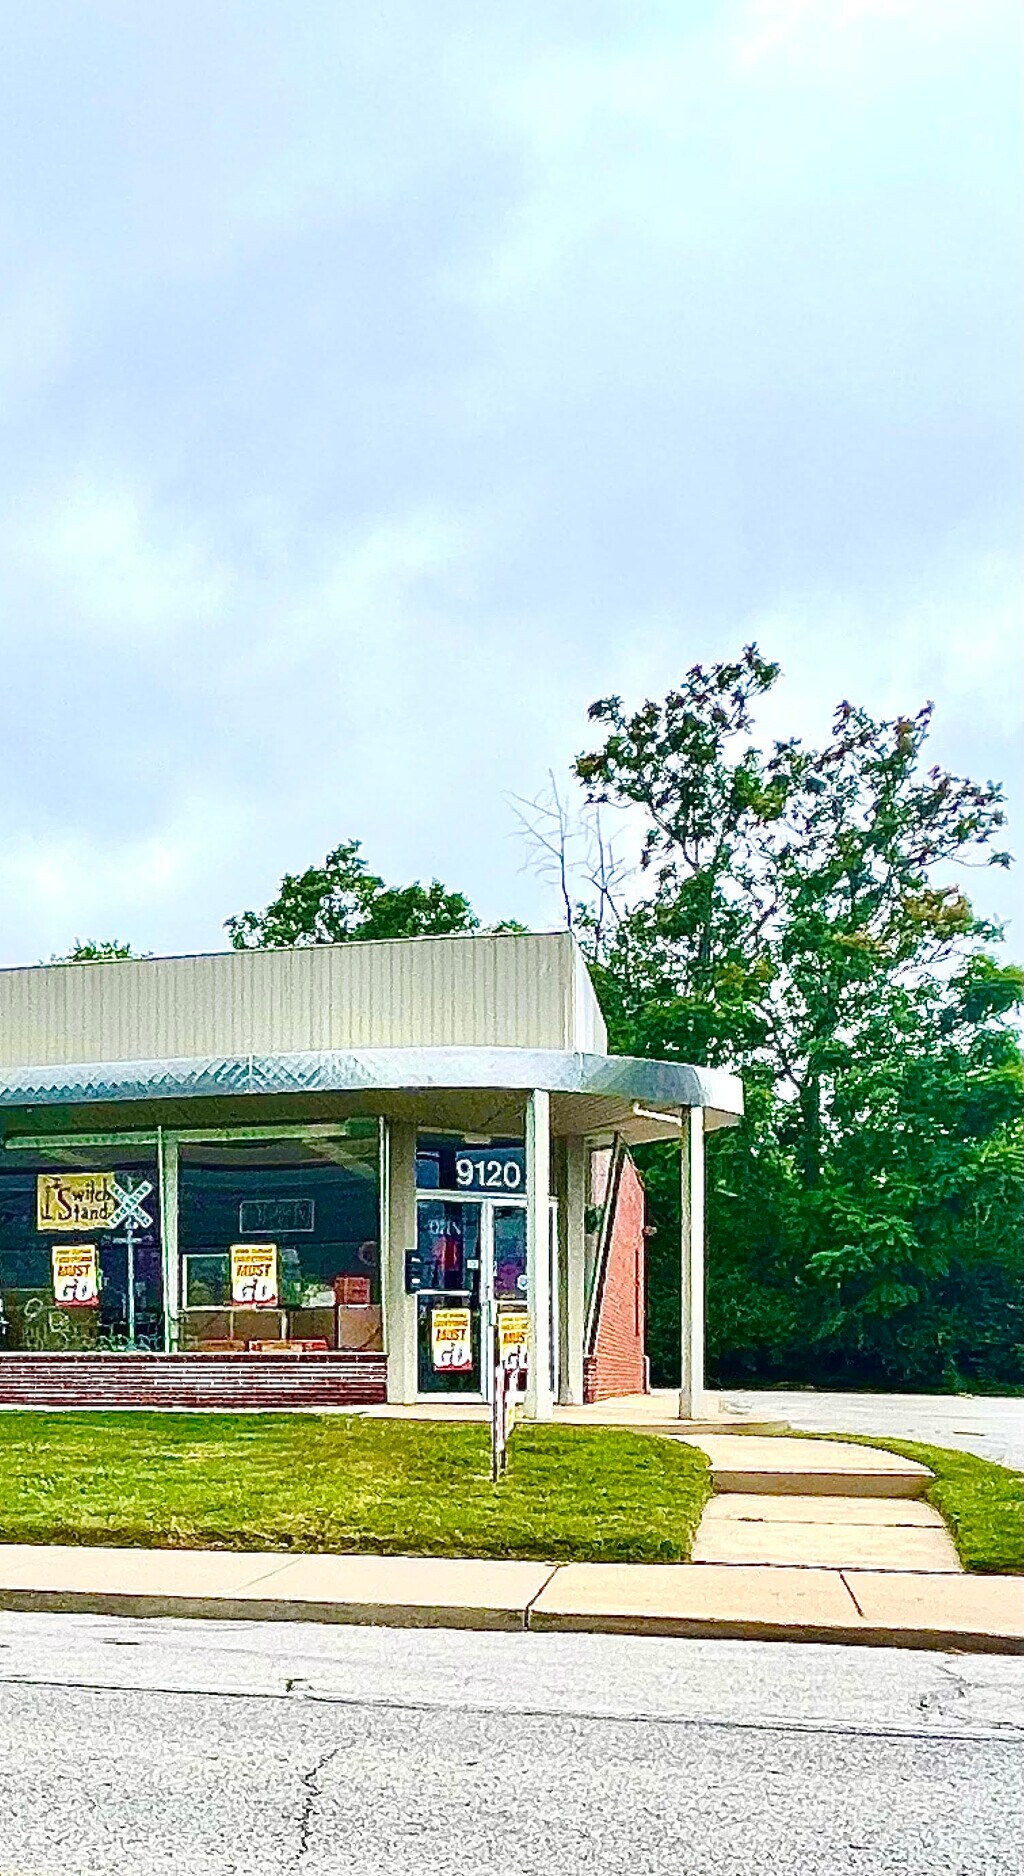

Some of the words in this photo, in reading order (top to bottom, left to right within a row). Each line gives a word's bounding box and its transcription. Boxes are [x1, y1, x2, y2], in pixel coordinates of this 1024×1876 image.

[456, 1159, 521, 1189] 9120
[237, 1264, 272, 1277] MUST
[502, 1332, 527, 1344] MUS
